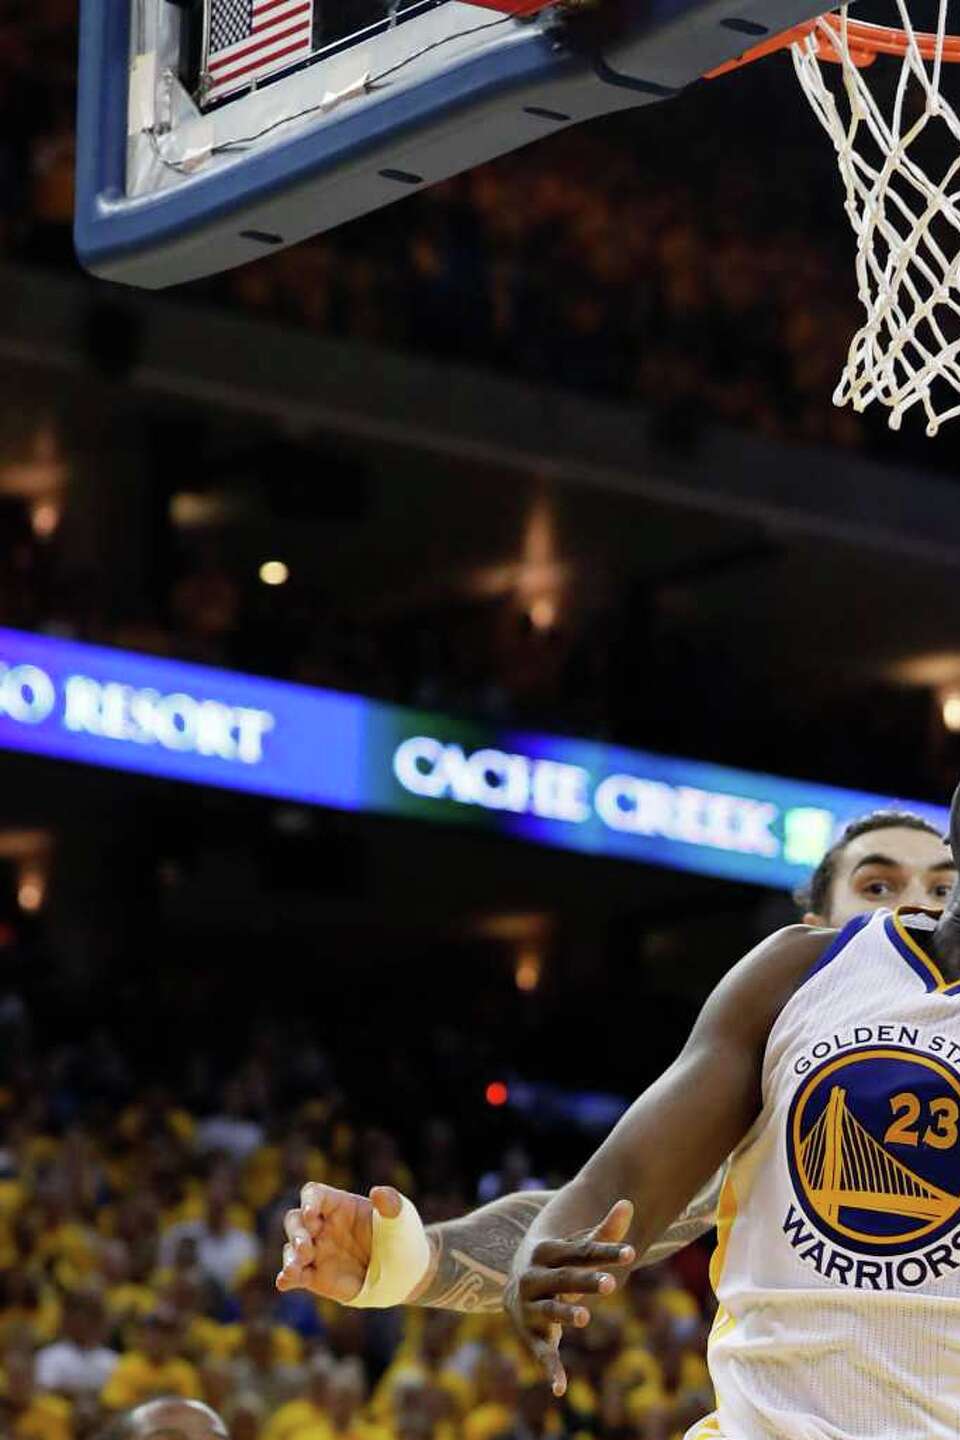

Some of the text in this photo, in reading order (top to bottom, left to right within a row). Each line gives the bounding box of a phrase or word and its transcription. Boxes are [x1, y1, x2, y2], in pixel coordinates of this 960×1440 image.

[65, 675, 275, 764] RESORT
[394, 736, 780, 858] CACHE CREEK
[793, 1024, 920, 1076] GOLDEN
[884, 1092, 960, 1150] 23
